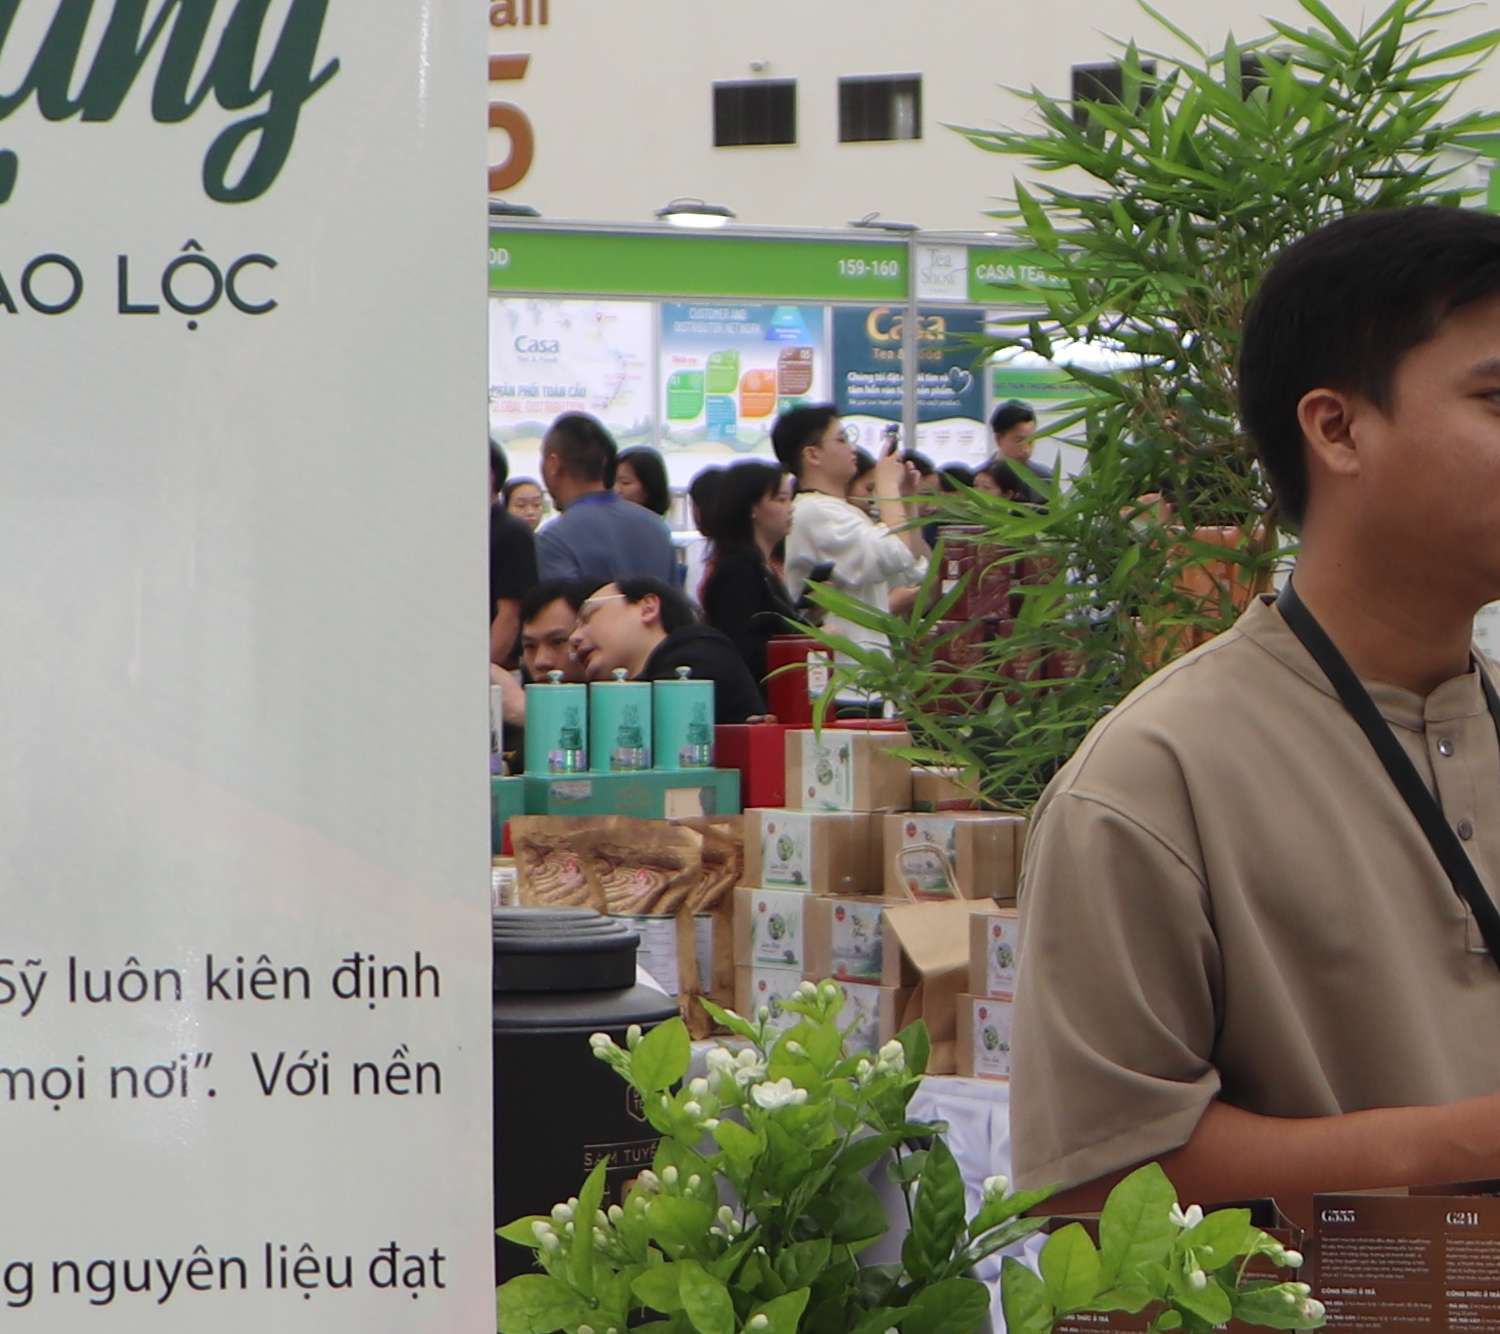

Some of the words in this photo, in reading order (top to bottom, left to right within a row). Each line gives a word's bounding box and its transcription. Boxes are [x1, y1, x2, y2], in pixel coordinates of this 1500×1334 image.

[927, 248, 952, 267] Tea
[838, 259, 899, 277] 159-160
[920, 267, 958, 287] Show
[976, 264, 1015, 281] CASA
[1018, 266, 1046, 283] TEA
[116, 237, 279, 331] LỘC
[514, 335, 559, 353] Casa
[69, 956, 181, 1003] luôn
[206, 954, 310, 1000] kiên
[332, 951, 440, 1010] định
[111, 1052, 216, 1099] nơi”.
[251, 1050, 329, 1096] Với
[353, 1044, 441, 1095] nền
